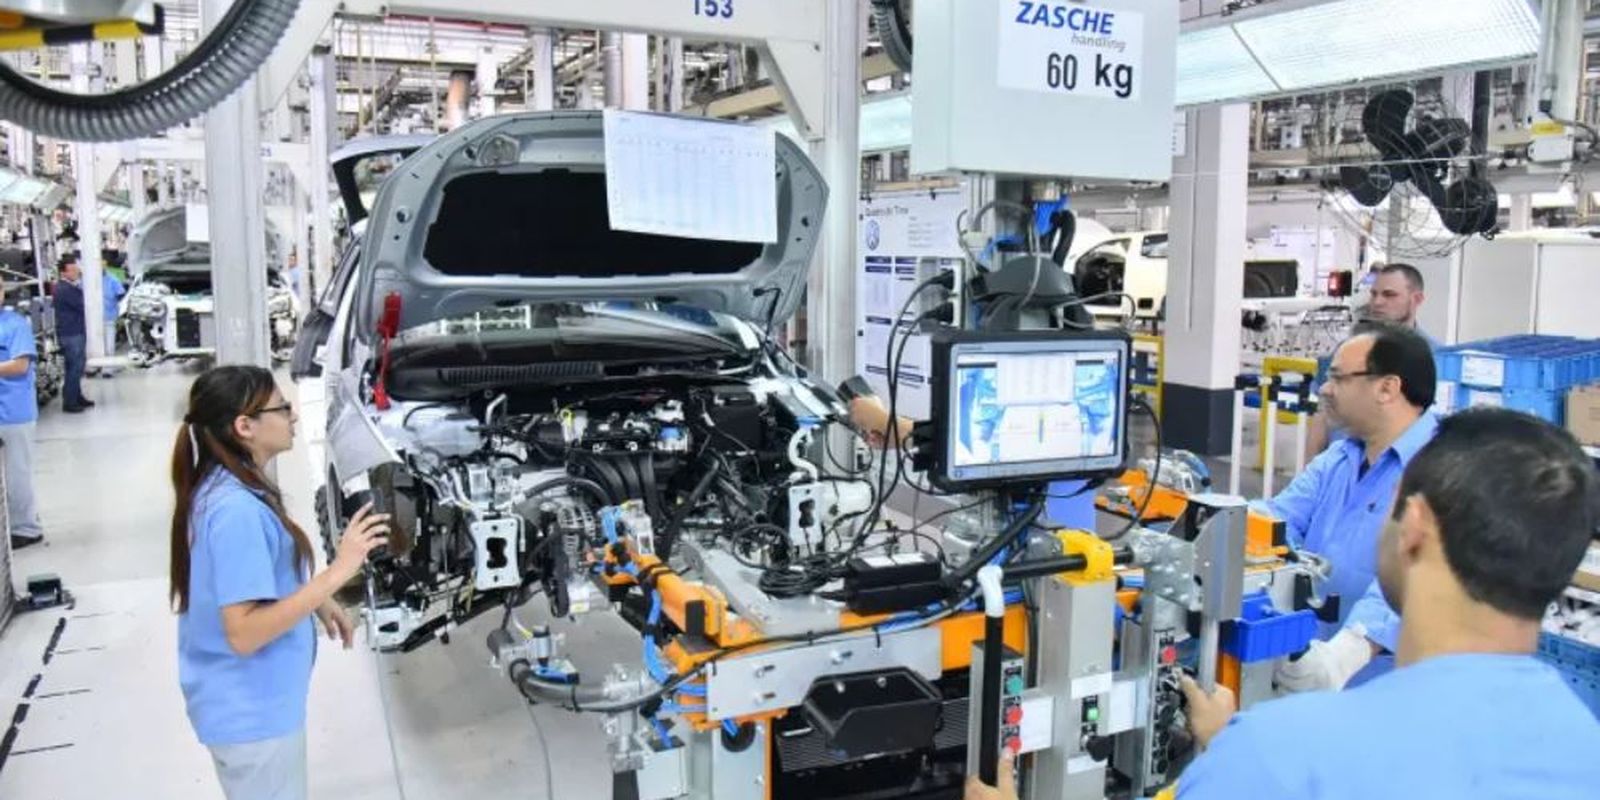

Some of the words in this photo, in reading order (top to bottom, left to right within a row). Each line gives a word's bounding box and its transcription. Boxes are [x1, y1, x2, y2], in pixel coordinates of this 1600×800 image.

[694, 0, 733, 18] 153
[1015, 1, 1114, 34] ZASCHE
[1071, 33, 1127, 53] handling
[1047, 52, 1078, 91] 60
[1095, 53, 1133, 99] kg
